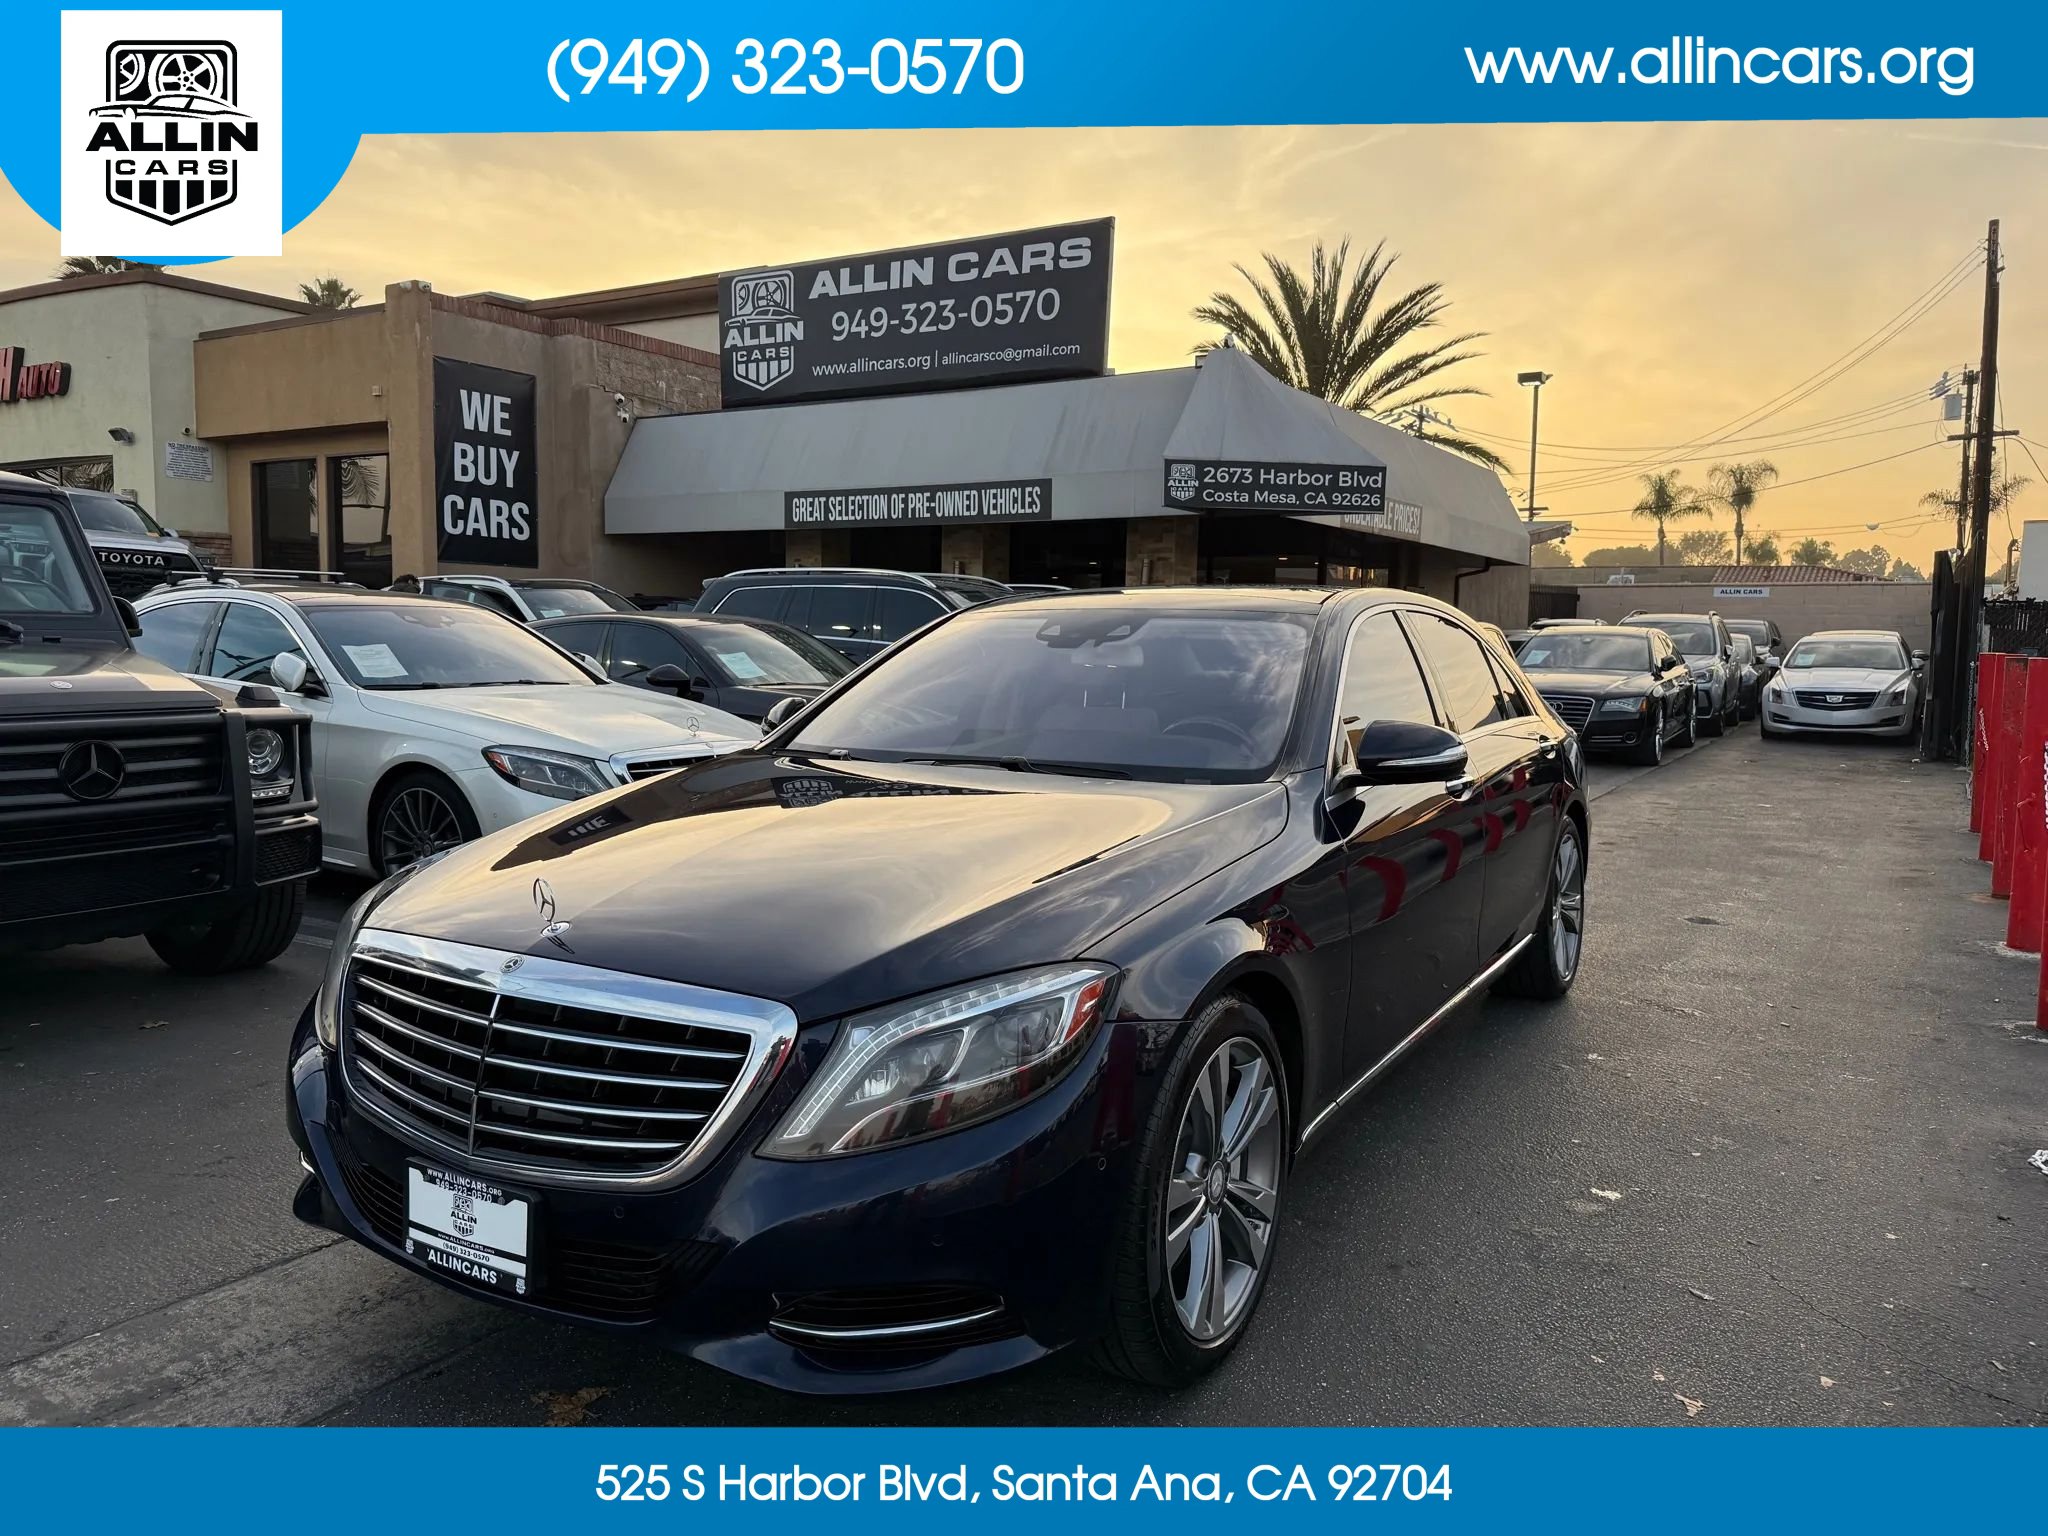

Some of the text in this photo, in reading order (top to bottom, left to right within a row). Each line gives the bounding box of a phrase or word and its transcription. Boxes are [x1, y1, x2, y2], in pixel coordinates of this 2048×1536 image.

[808, 236, 1092, 299] ALLIN CARS
[831, 288, 1061, 341] 949-323-0570
[723, 320, 804, 349] ALLIN
[737, 346, 790, 361] CARS
[812, 342, 1080, 377] www.allincars.org allincarsco@gmail.com
[17, 360, 64, 398] AUTO
[459, 389, 512, 436] WE
[454, 441, 520, 488] BUY
[1203, 466, 1383, 488] 2673 Harbor Blvd
[1168, 479, 1199, 487] ALLIN
[1202, 489, 1381, 507] Costa Mesa, CA 92626
[444, 494, 530, 541] CARS
[792, 486, 1041, 522] GREAT SELECTION OF PRE-OWNED VEHICLES
[1393, 503, 1420, 535] PRICES!
[99, 552, 165, 566] TOYOTA
[435, 1178, 493, 1203] 949-323-0570
[451, 1211, 477, 1225] ALLIN
[428, 1249, 498, 1284] ALLINCARS
[459, 1247, 490, 1262] 323-0570
